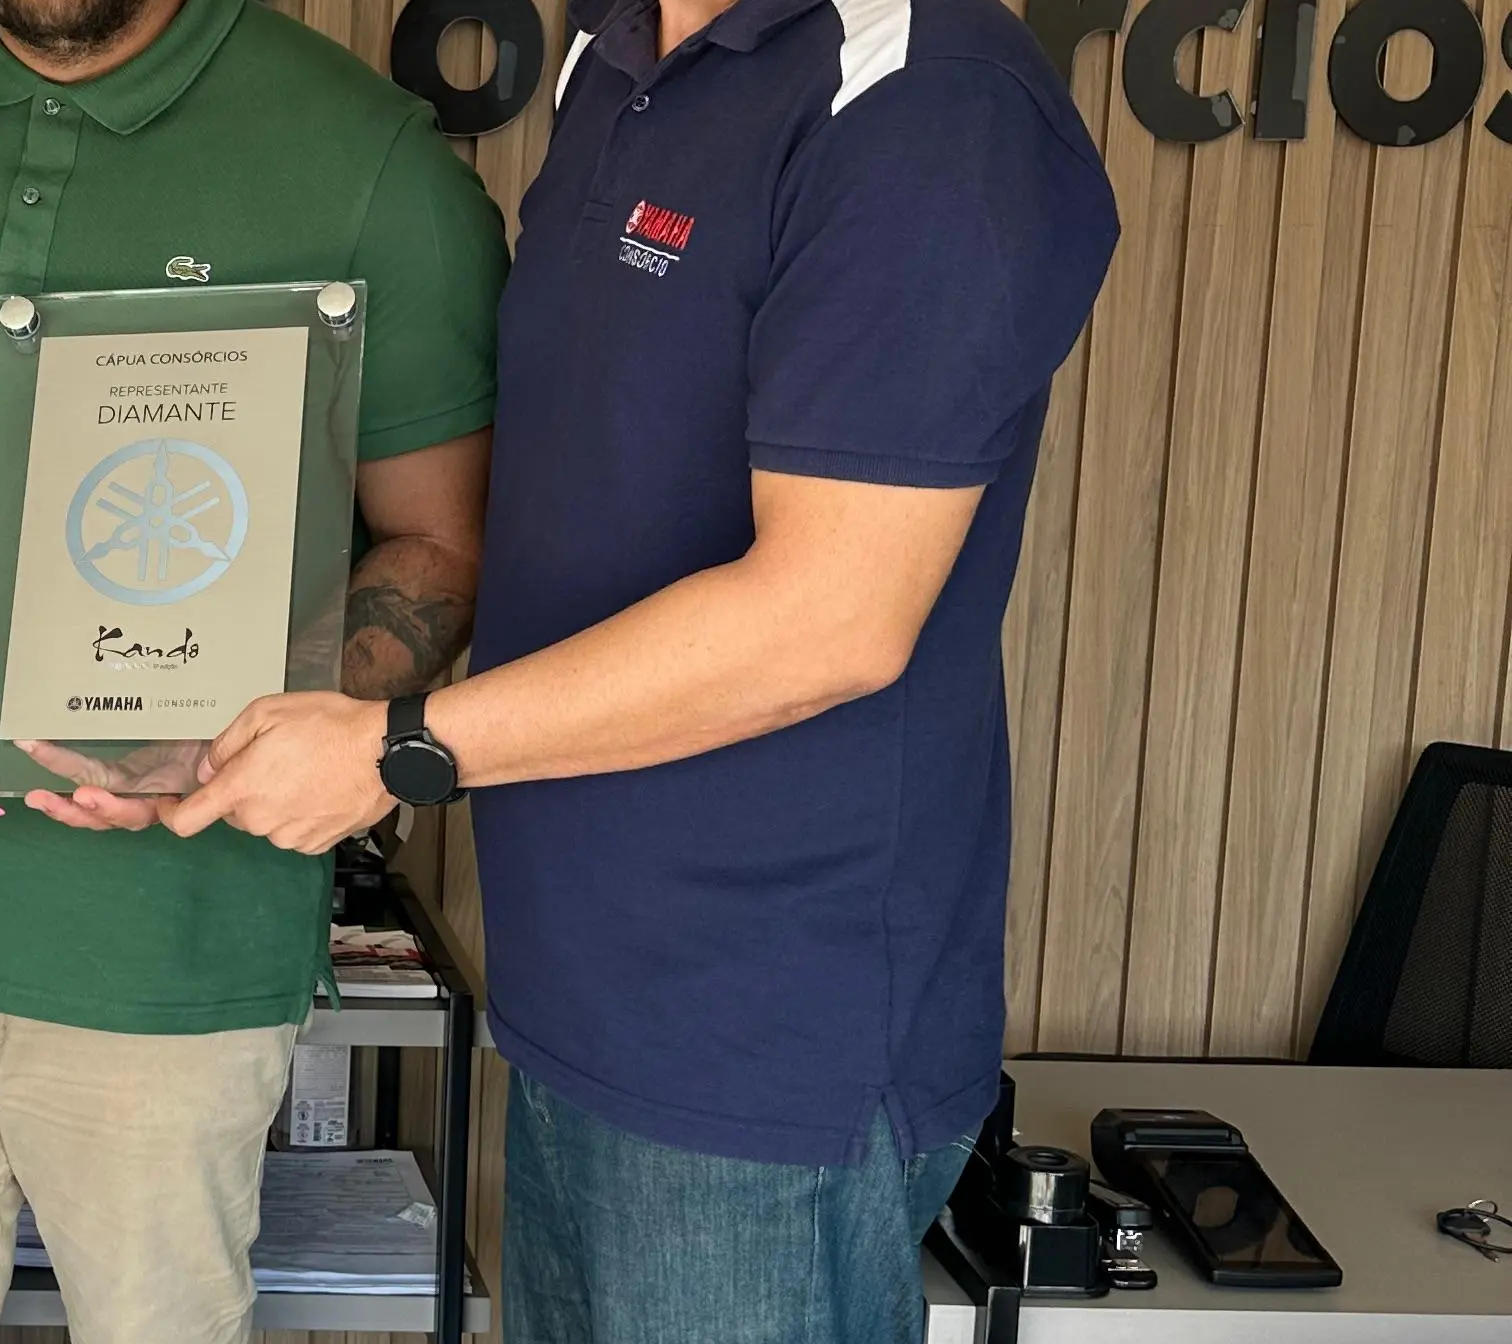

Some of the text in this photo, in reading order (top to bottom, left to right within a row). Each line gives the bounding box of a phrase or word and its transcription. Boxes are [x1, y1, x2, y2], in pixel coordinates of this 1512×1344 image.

[637, 203, 695, 252] YAMAHA
[95, 350, 248, 367] CÁPUA CONSÓRCIOS
[109, 382, 229, 398] REPRESENTANTE
[97, 401, 237, 425] DIAMANTE
[92, 625, 199, 665] Kando
[84, 696, 144, 712] YAMAHA
